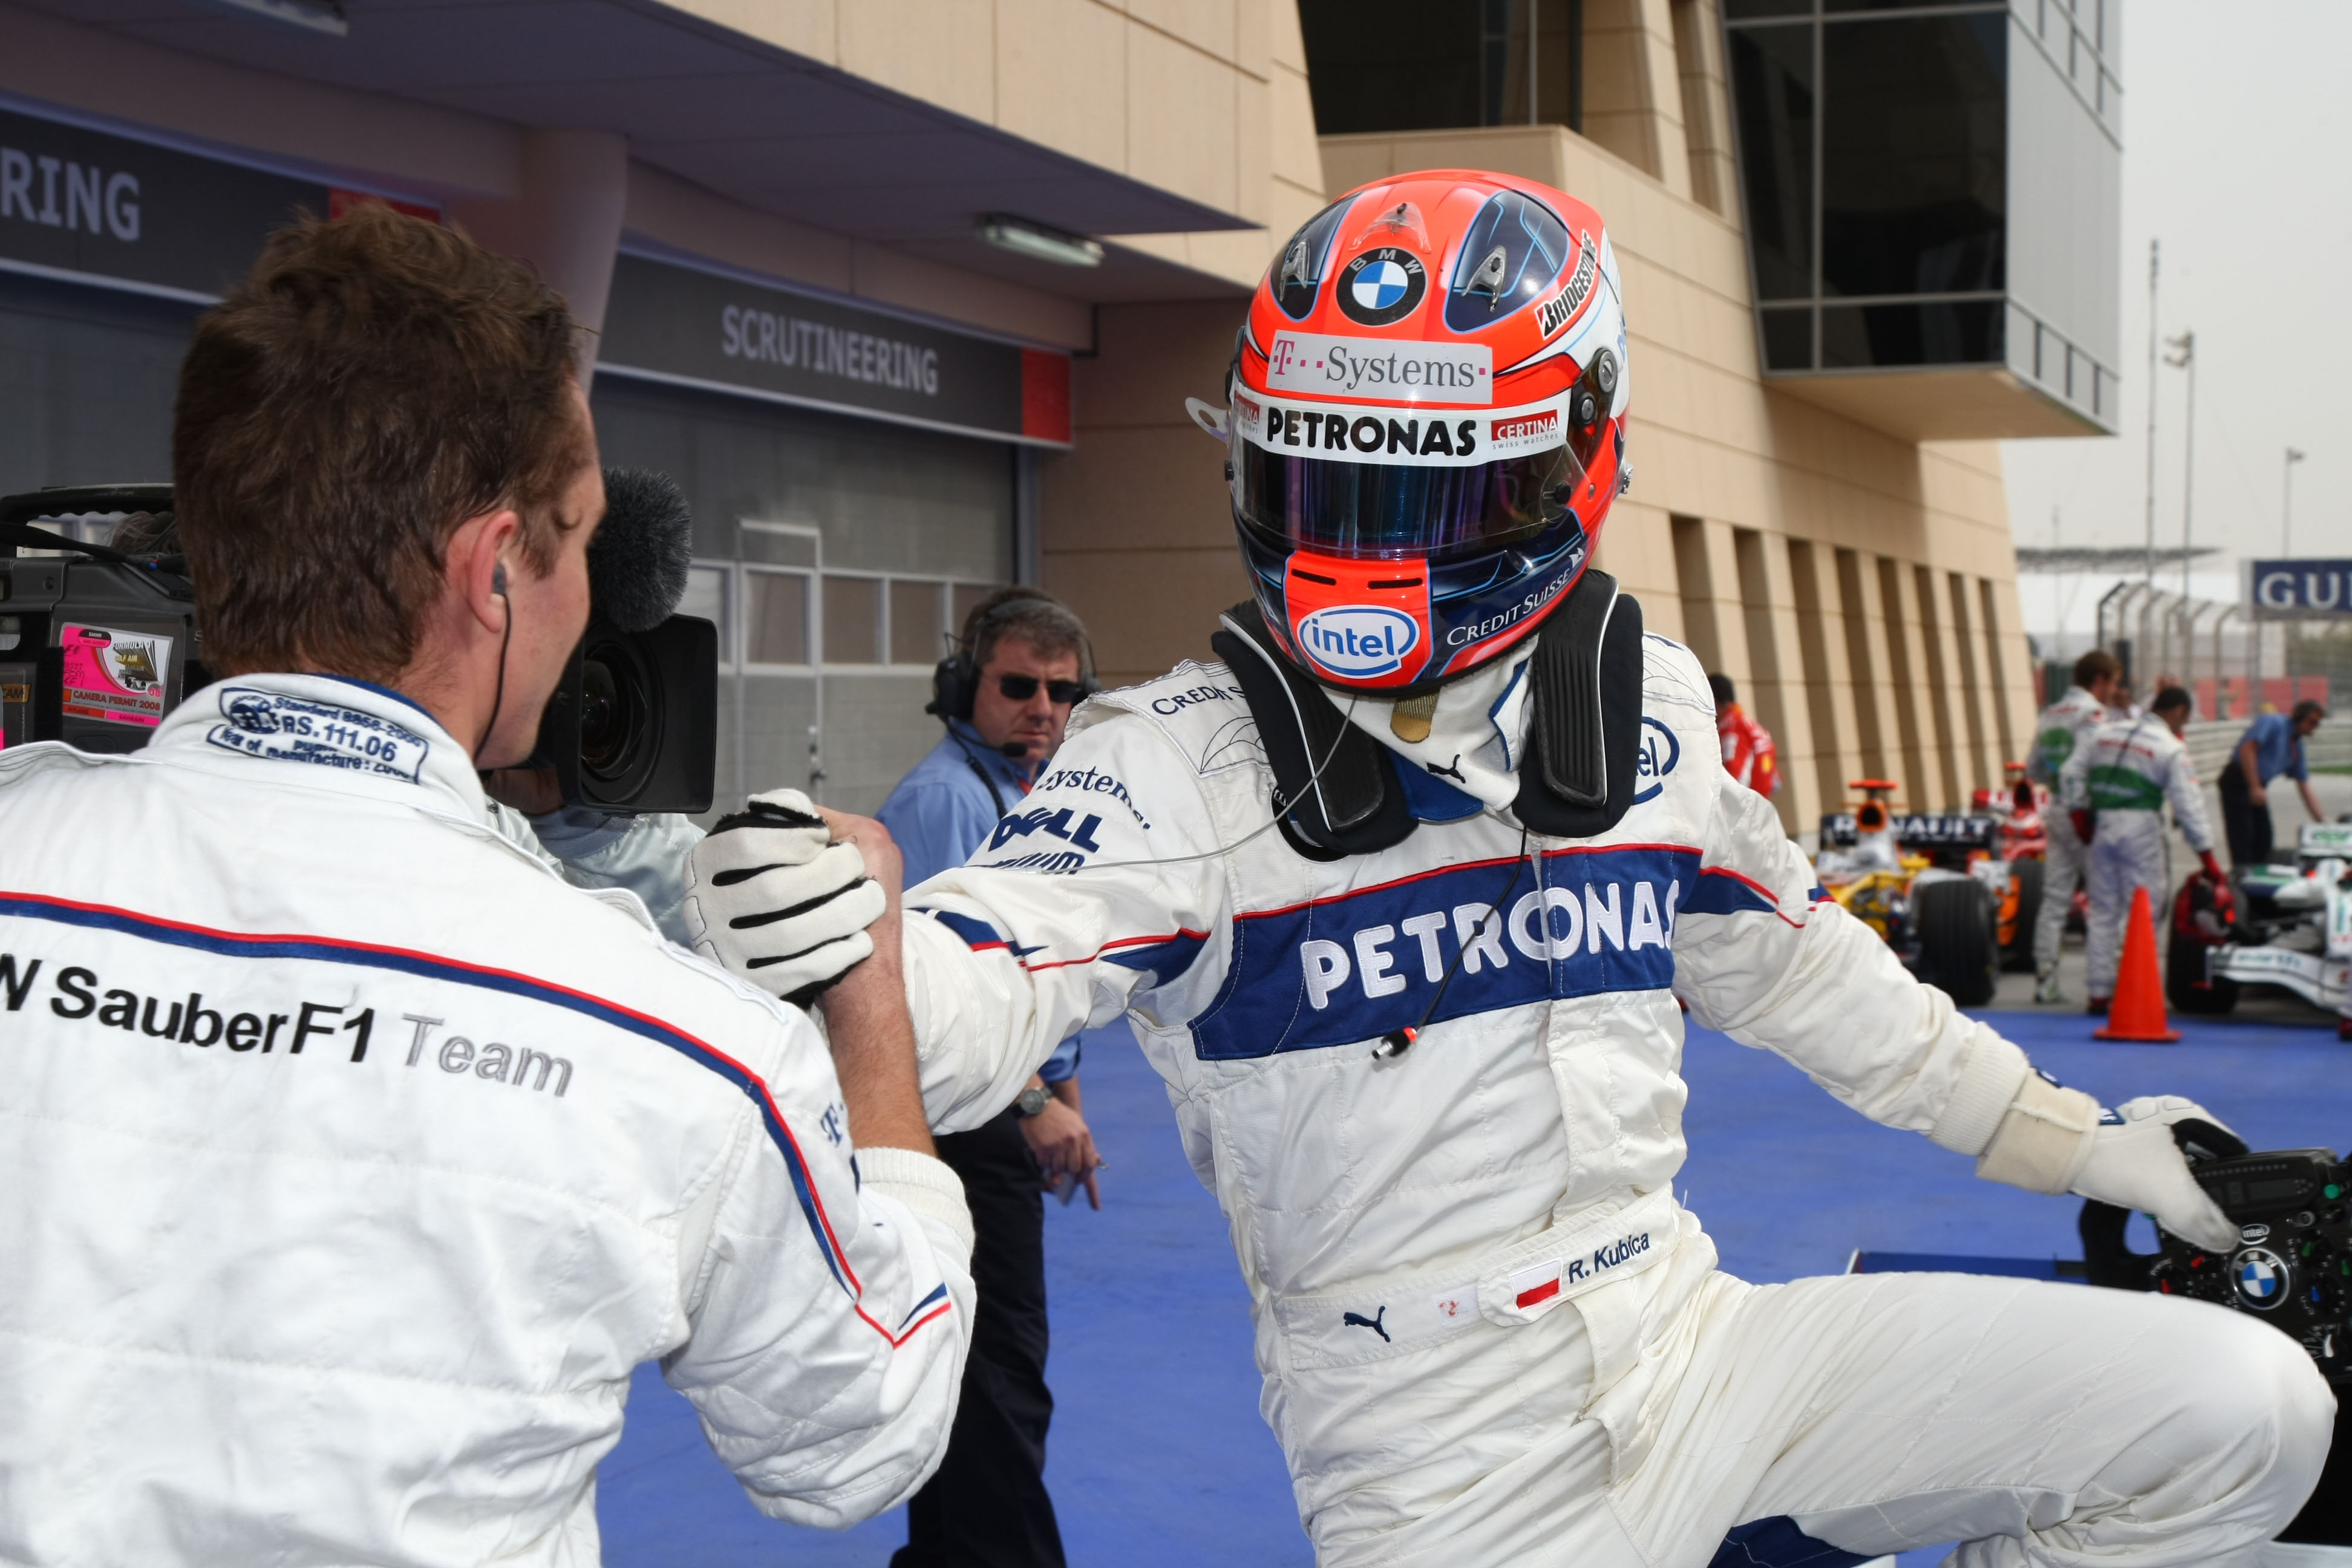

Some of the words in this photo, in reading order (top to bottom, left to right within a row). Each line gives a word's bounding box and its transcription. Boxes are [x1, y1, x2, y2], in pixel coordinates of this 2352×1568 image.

[0, 146, 140, 241] RING
[1349, 249, 1423, 275] BMW
[1537, 231, 1596, 338] BRIDGESTONE
[722, 305, 938, 396] SCRUTINEERING
[1267, 407, 1476, 457] PETRONAS
[1492, 441, 1519, 450] swiss
[1523, 433, 1558, 445] watches
[1497, 416, 1558, 440] CERTINA
[2258, 571, 2352, 610] GU
[1312, 618, 1395, 658] intel
[73, 690, 107, 703] CAMERA
[109, 696, 138, 707] PERMIT
[139, 700, 161, 711] 2008
[273, 697, 340, 720] Standard
[246, 739, 263, 754] of
[281, 715, 397, 762] RS.111.06
[988, 807, 1103, 854] DELL
[1832, 814, 1990, 836] RNAULT
[400, 1012, 574, 1099] Team
[1569, 1259, 1590, 1284] R.
[1594, 1232, 1650, 1273] Kubica
